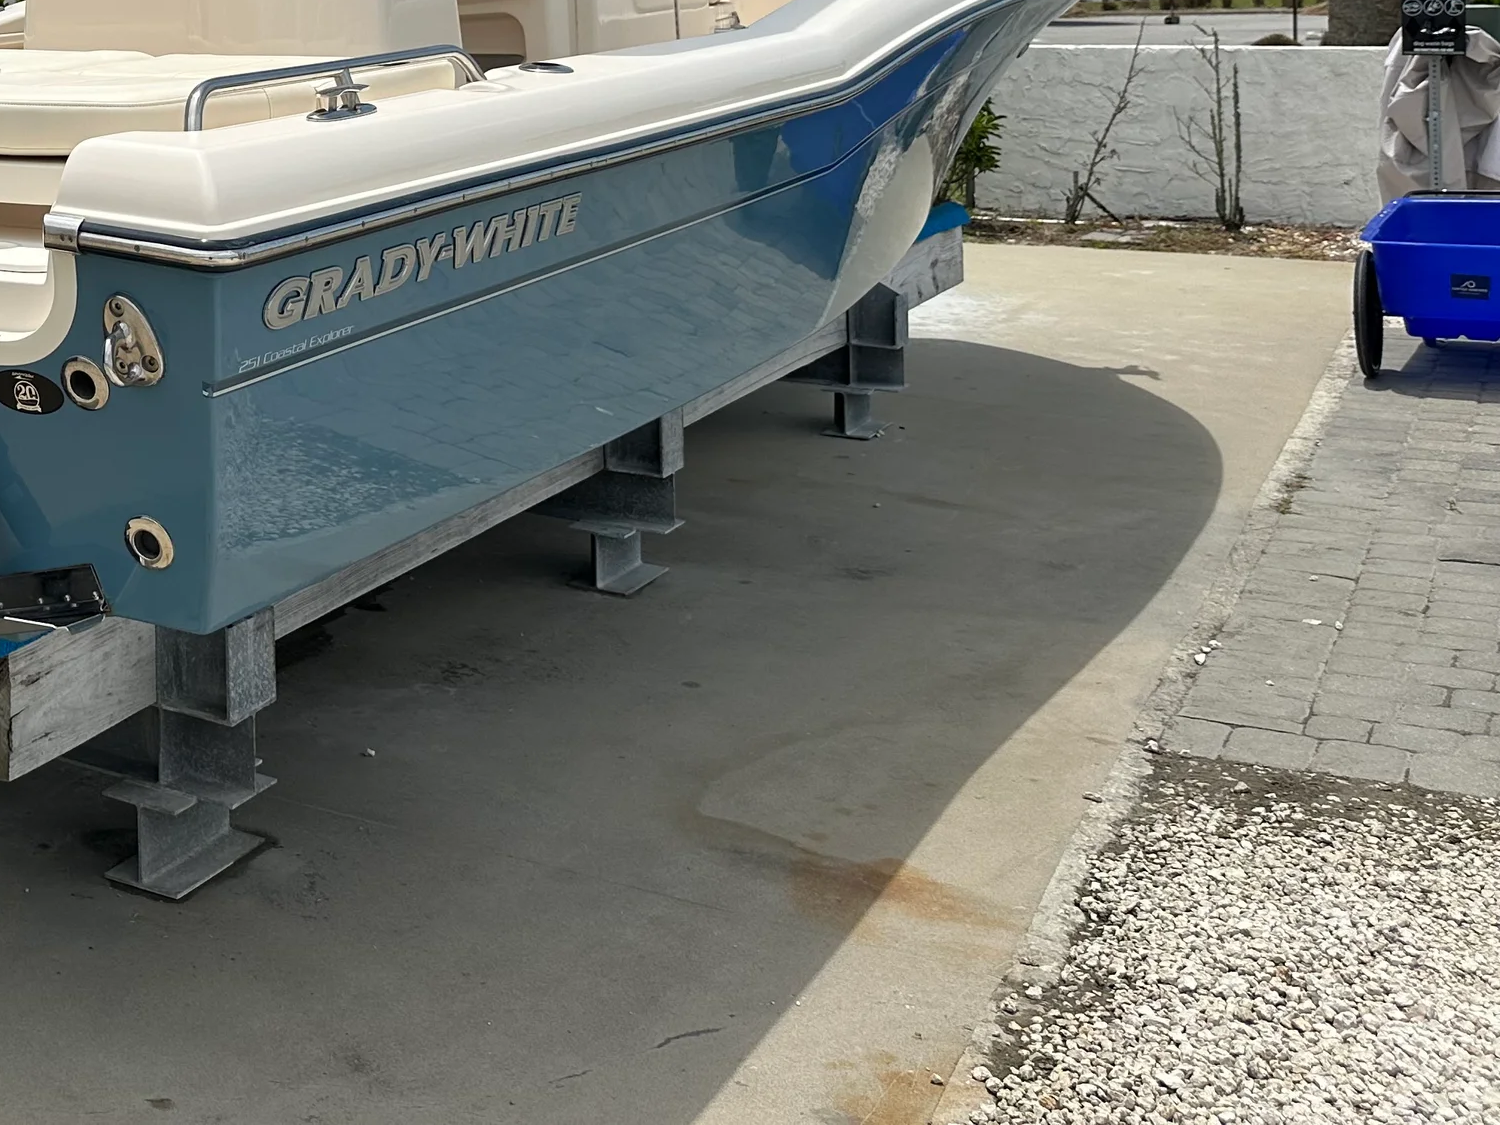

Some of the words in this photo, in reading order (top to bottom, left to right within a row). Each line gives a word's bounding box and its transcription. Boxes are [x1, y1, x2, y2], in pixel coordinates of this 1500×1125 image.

[262, 192, 583, 331] GRADY-WHITE
[238, 355, 261, 374] 251
[263, 339, 307, 364] Coastal
[309, 325, 355, 348] Explorer
